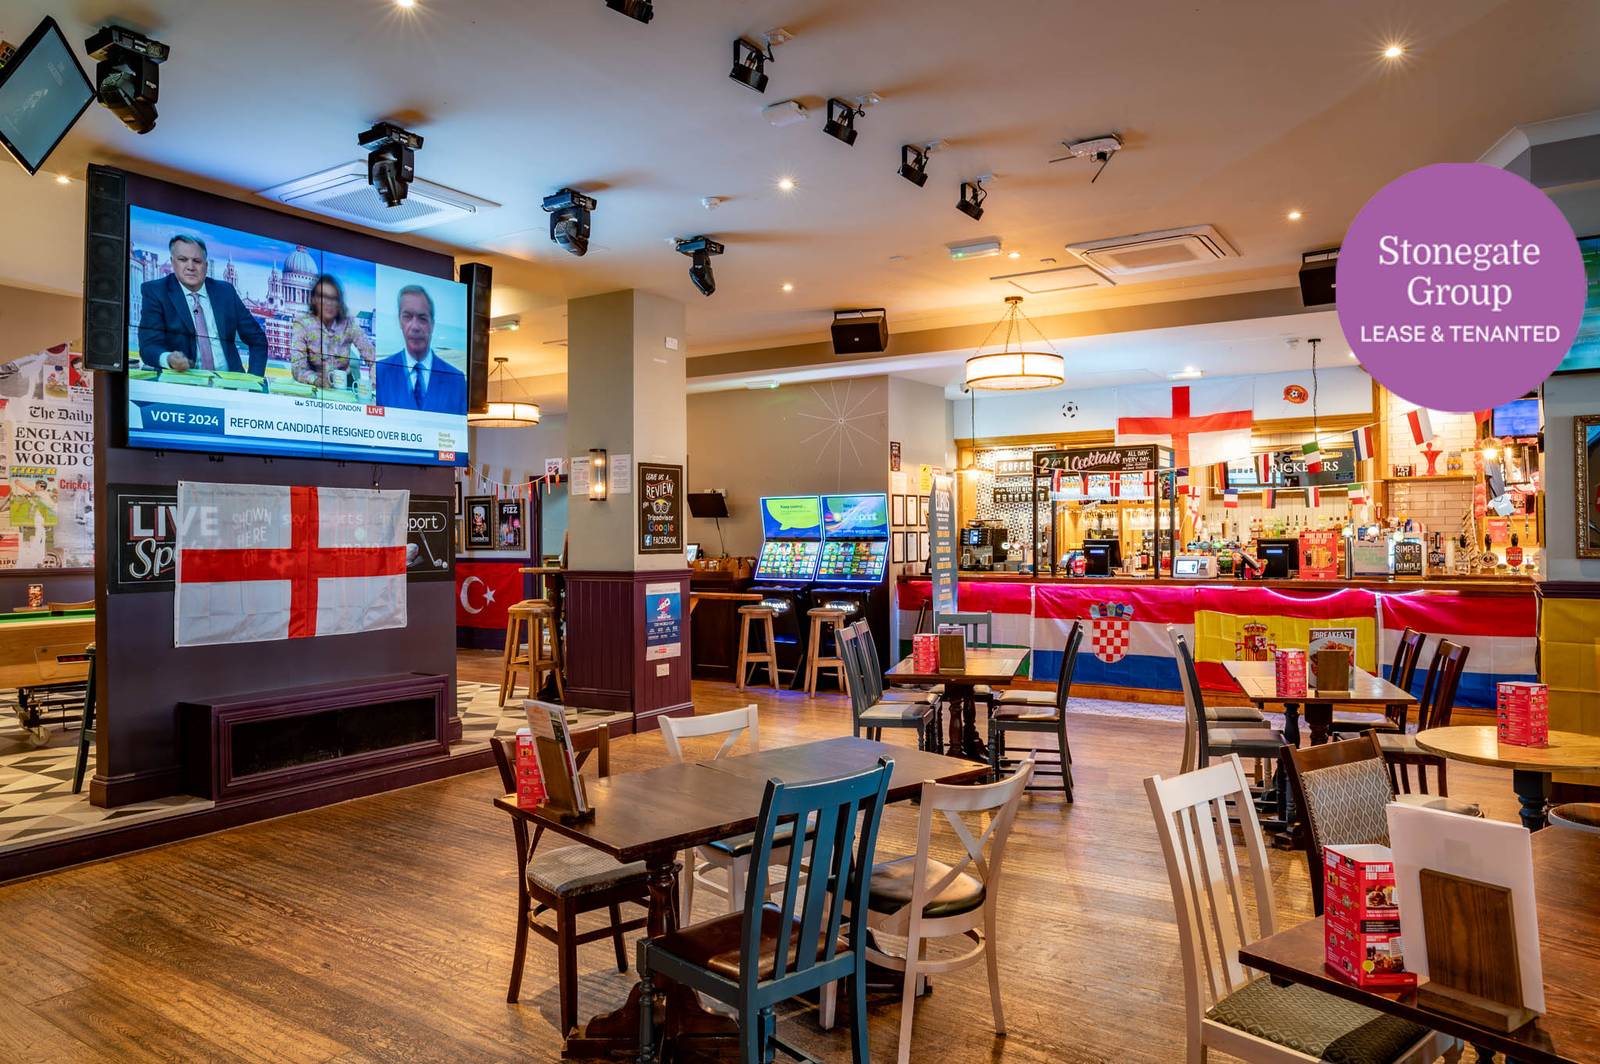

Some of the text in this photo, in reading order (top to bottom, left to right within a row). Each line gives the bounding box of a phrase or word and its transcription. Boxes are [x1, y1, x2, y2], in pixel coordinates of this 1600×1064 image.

[305, 400, 334, 409] STUDIOS
[335, 402, 362, 413] LONDON
[368, 407, 384, 415] LIVE
[28, 405, 93, 424] The Daily
[150, 409, 219, 427] VOTE 2024
[230, 417, 423, 443] REFORM CANDIDATE RESIGNED OVER BLOG
[15, 440, 94, 455] ICC CRIC
[15, 453, 78, 466] WORLD
[1040, 457, 1050, 473] 2
[1063, 456, 1070, 472] 1
[1071, 451, 1122, 470] Cocktails
[646, 482, 674, 499] REVIEW
[503, 506, 519, 514] FIZZ
[130, 505, 219, 541] LIVE
[406, 515, 439, 533] port
[648, 521, 674, 535] Google
[653, 536, 677, 545] FACEBOOK
[1395, 544, 1421, 554] SIMPLE
[1395, 562, 1422, 571] DIMPLE
[1315, 631, 1353, 640] BREAKFAST
